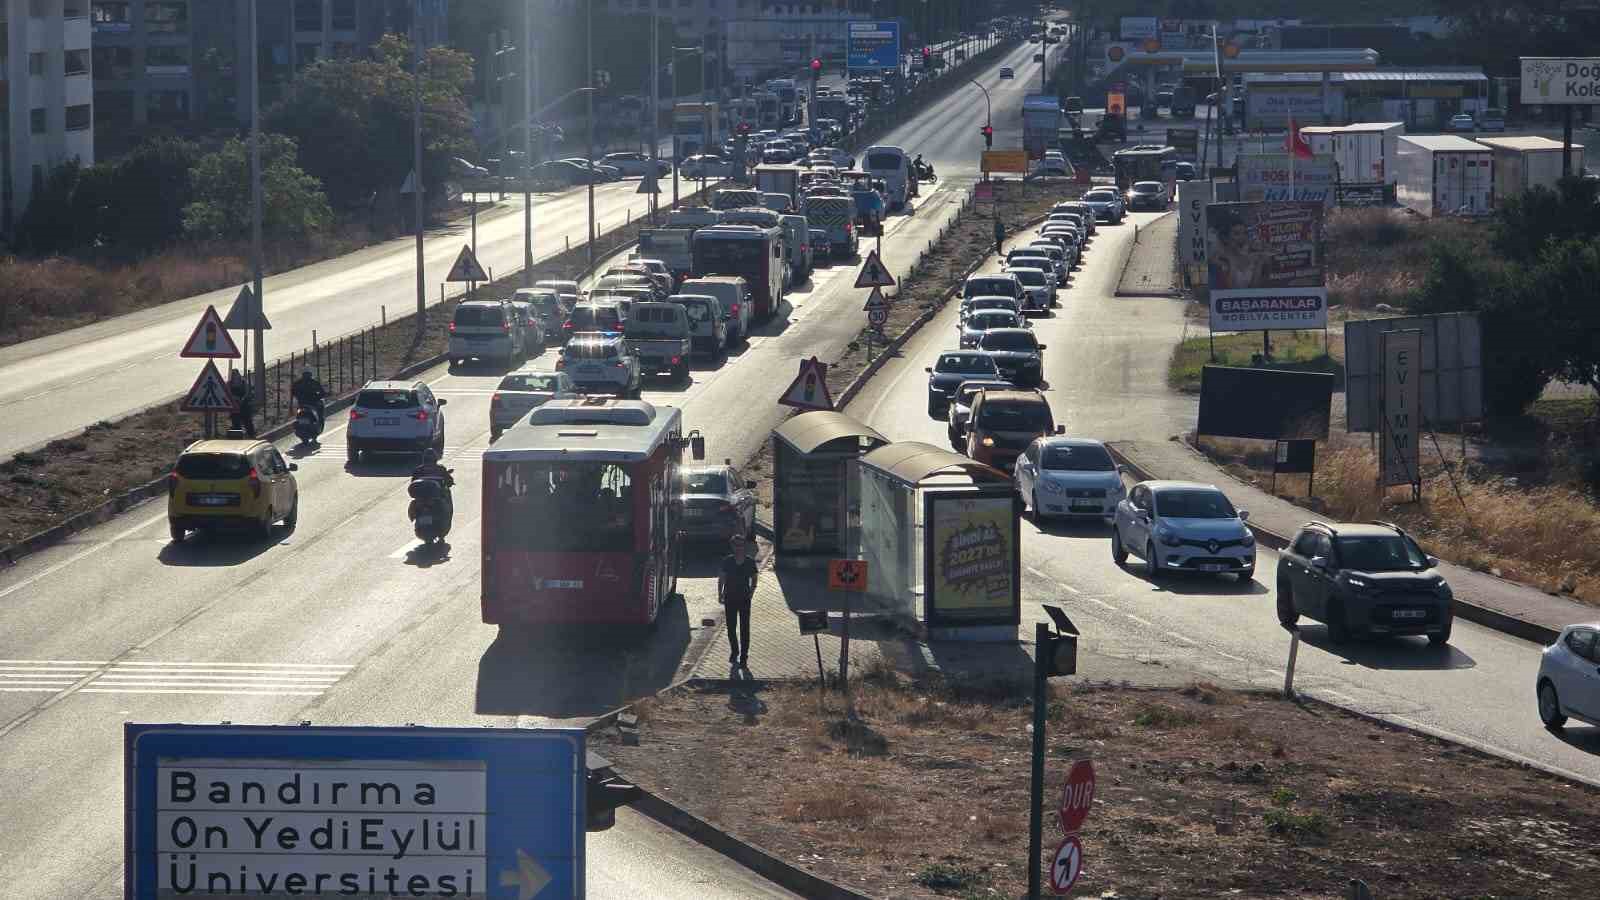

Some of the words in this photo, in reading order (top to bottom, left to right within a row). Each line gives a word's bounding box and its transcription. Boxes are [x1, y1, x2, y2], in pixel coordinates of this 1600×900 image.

[170, 771, 437, 805] Bandırma
[1063, 782, 1093, 809] DUR
[169, 855, 474, 898] Üniversitesi
